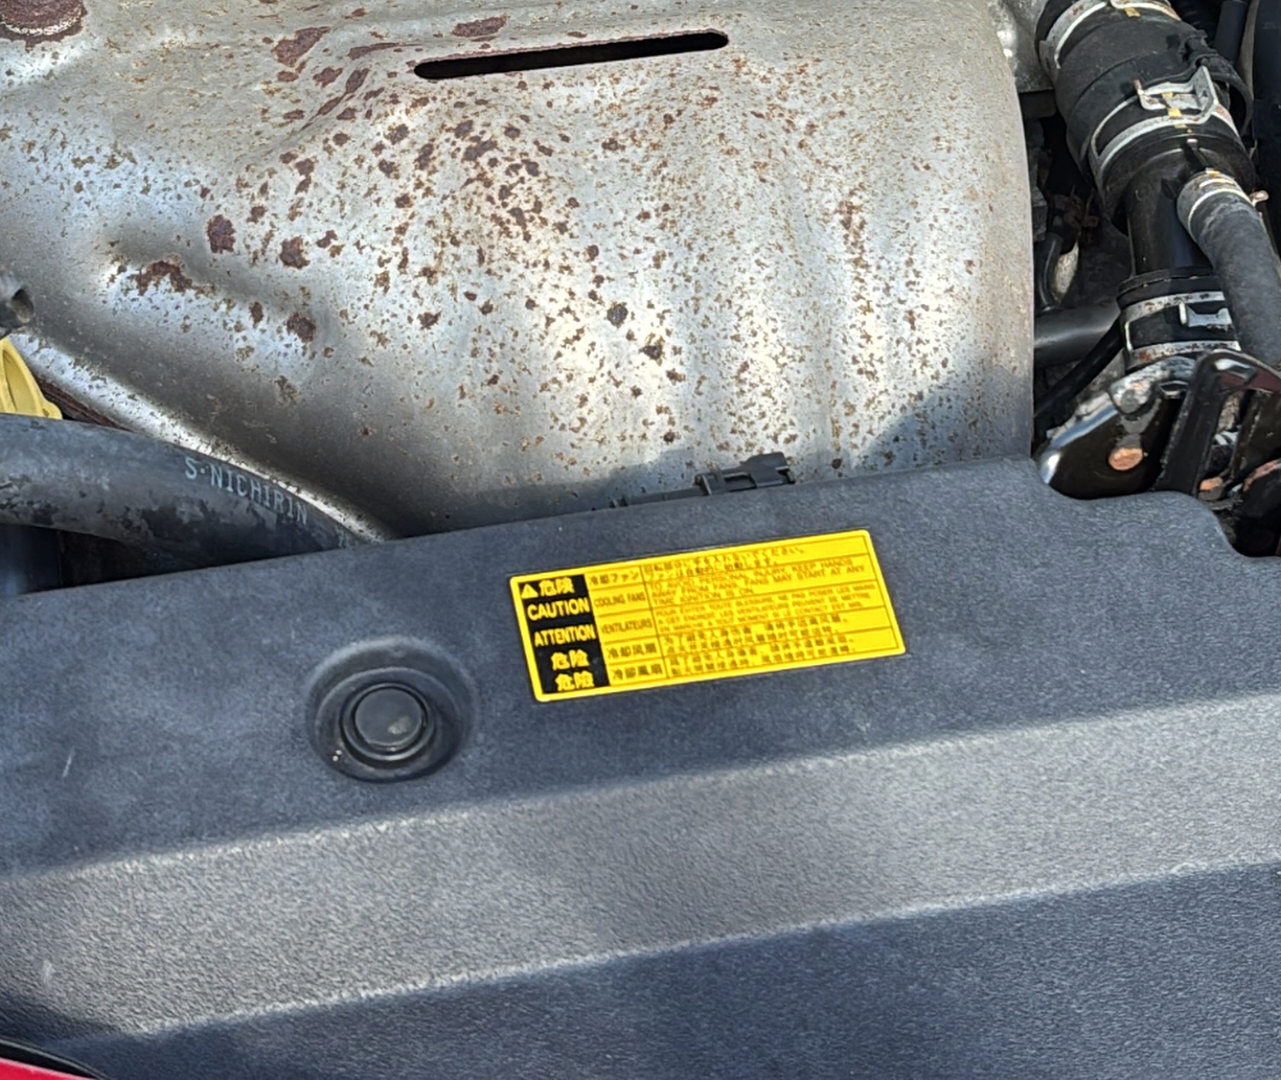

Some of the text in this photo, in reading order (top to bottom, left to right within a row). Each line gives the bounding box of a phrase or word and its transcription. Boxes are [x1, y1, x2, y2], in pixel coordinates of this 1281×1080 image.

[525, 596, 591, 621] CAUTION
[592, 591, 646, 607] COOLING FANS
[531, 622, 596, 647] ATTENTION
[599, 618, 652, 634] VENTILATEURS
